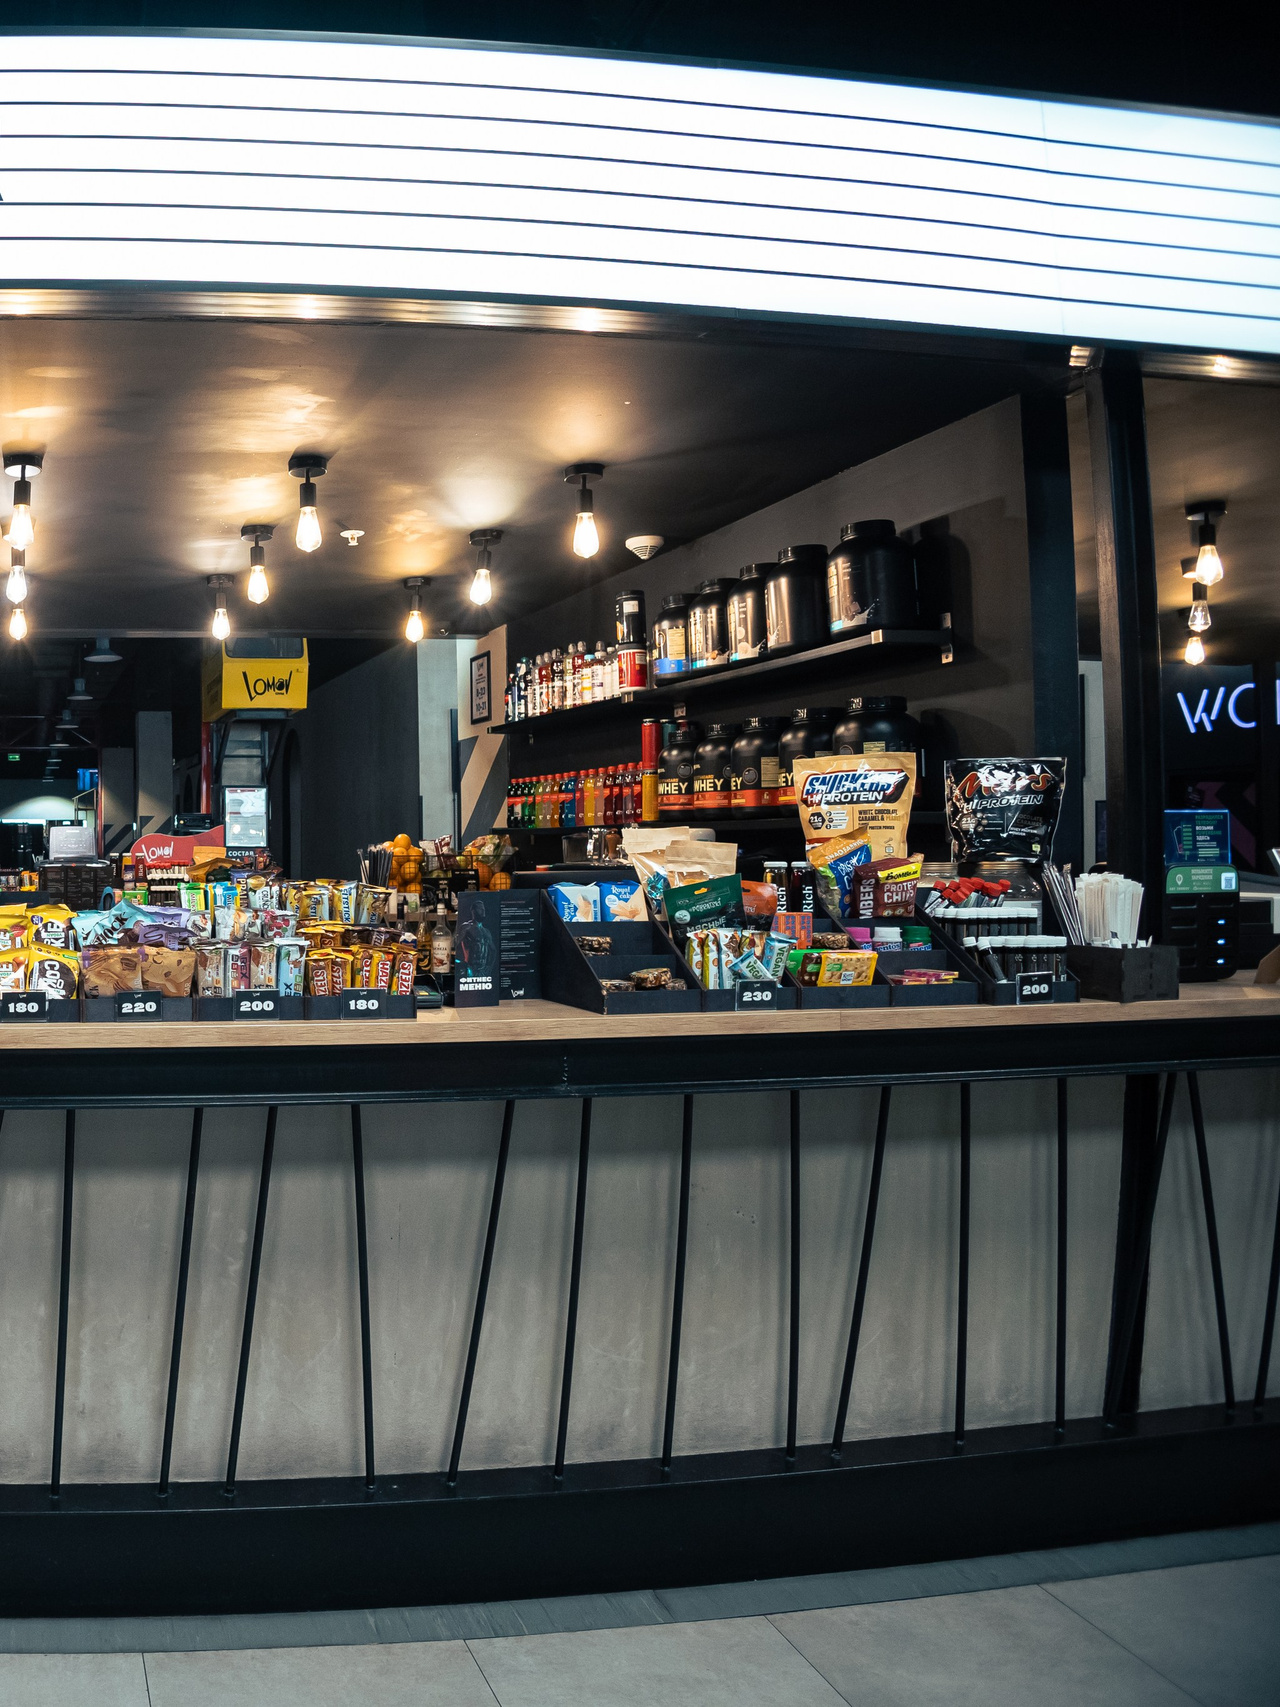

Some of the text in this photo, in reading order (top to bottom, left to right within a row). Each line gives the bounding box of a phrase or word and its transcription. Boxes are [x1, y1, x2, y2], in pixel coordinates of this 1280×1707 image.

[1177, 682, 1257, 734] WC
[658, 781, 689, 795] WHEY
[694, 778, 724, 792] WHEY
[731, 777, 743, 791] EY
[823, 791, 884, 803] PROTEIN
[977, 794, 1044, 810] PROTEIN
[610, 884, 631, 897] Royal
[776, 887, 787, 913] Rich
[803, 886, 814, 913] Rich
[309, 896, 319, 918] FITSTI
[562, 901, 571, 922] Royal
[687, 916, 727, 933] МЯСНЫЕ
[240, 956, 250, 980] REX
[771, 946, 787, 978] VEGAN
[745, 961, 765, 980] VEGA
[398, 961, 413, 996] AZELS
[459, 983, 493, 991] МЕНЮ
[1022, 983, 1049, 995] 200
[742, 990, 772, 1001] 230
[7, 1002, 39, 1013] 180
[121, 1001, 157, 1013] 220
[239, 1000, 274, 1012] 200
[348, 999, 379, 1010] 180
